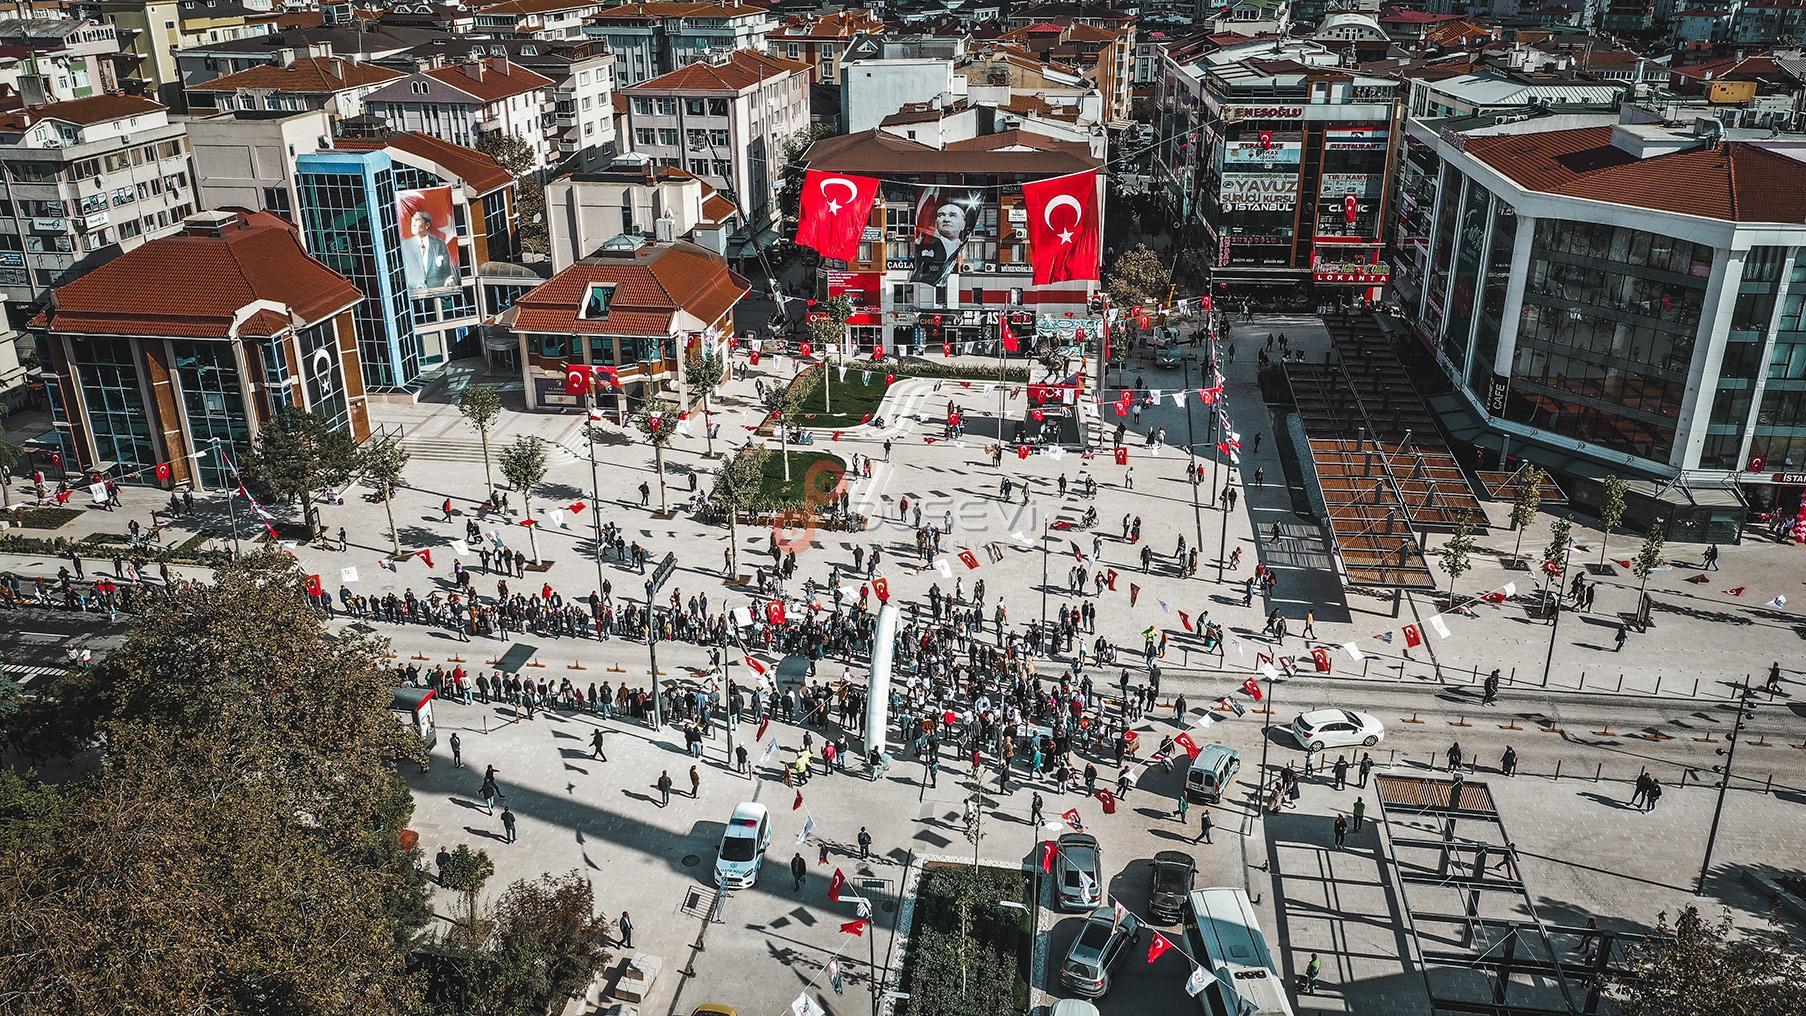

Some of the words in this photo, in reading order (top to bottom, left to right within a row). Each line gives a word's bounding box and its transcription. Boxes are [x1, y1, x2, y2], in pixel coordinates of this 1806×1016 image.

[1235, 180, 1297, 192] YAVUZ
[1263, 194, 1296, 203] KURSU
[1328, 204, 1369, 213] CLIC
[1317, 274, 1387, 282] LOKANTA
[1492, 383, 1506, 410] CAFE
